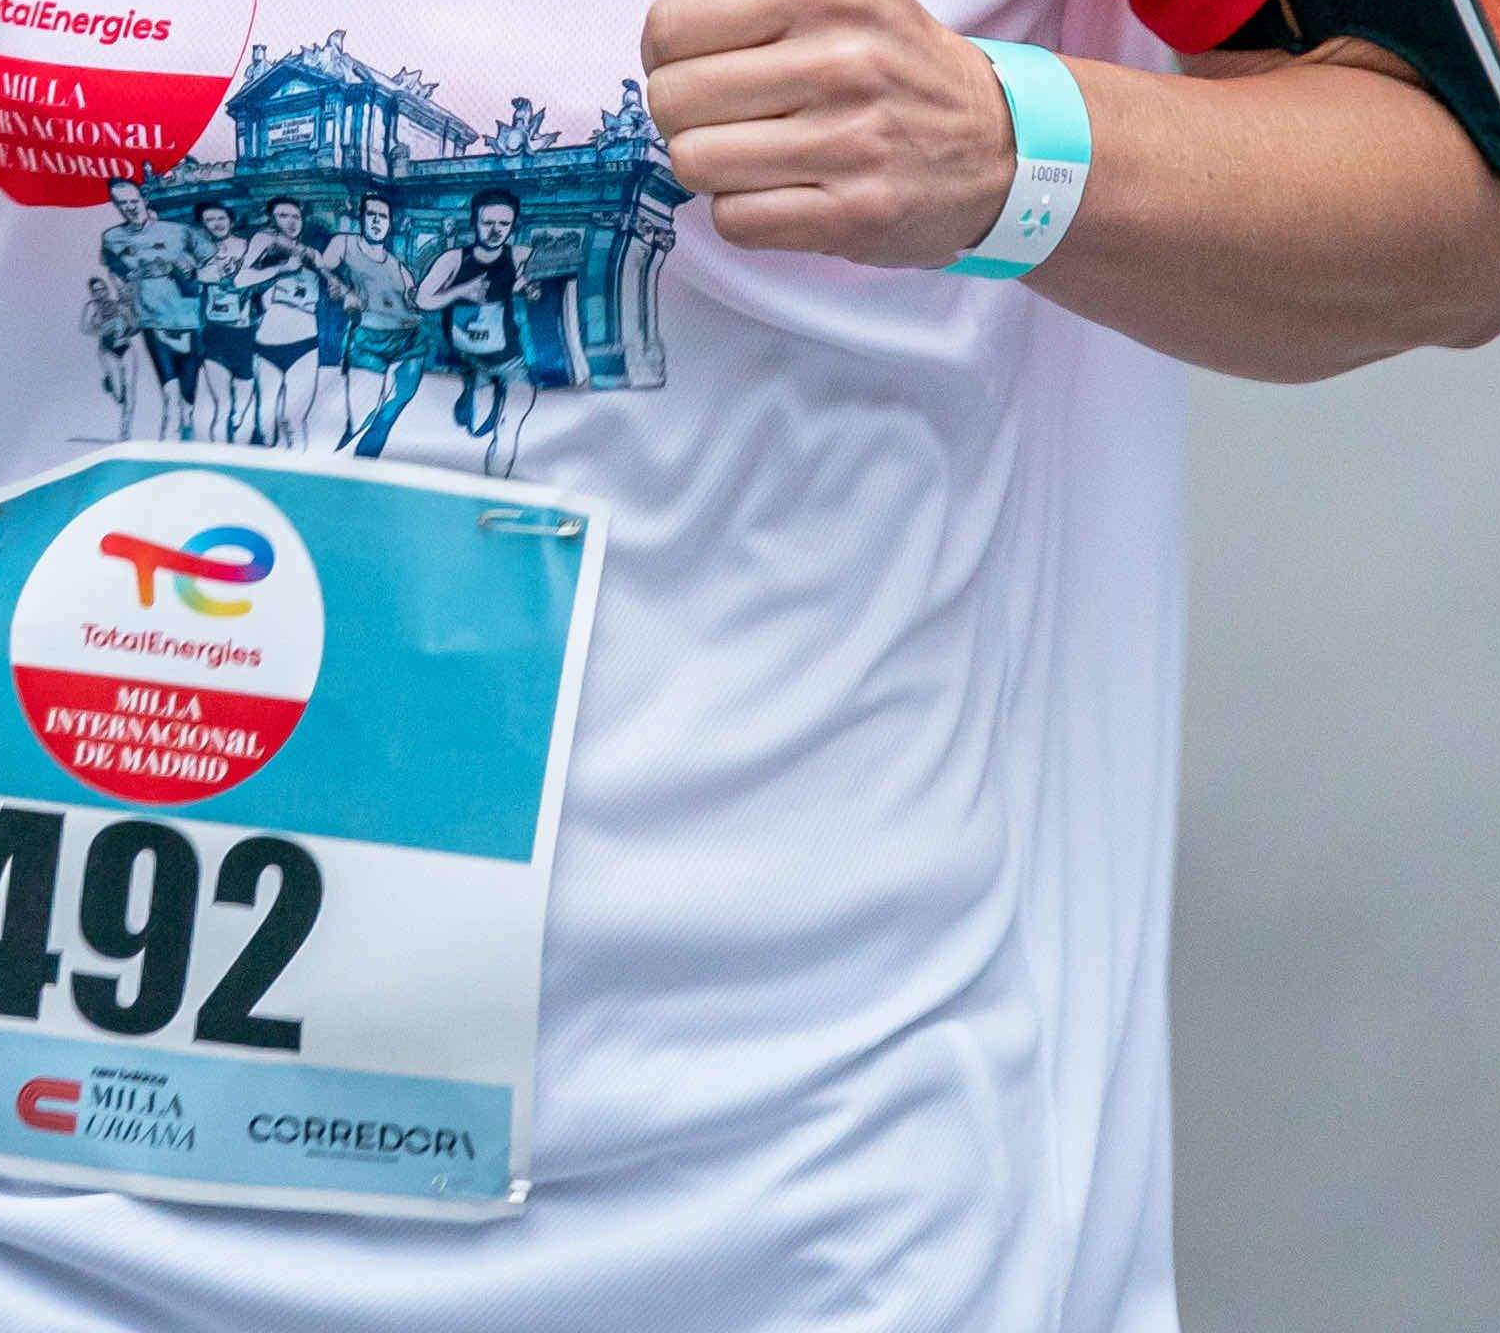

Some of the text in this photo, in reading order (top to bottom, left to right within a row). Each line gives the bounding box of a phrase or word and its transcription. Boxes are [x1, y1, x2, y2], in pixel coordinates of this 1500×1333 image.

[1, 72, 86, 109] MILLA
[16, 146, 136, 179] MADRID
[81, 623, 263, 669] TotalEnergies
[115, 685, 202, 721] MILLA
[73, 740, 229, 783] DE MADRID
[91, 1082, 184, 1119] MILLA
[85, 1112, 196, 1151] URBANA
